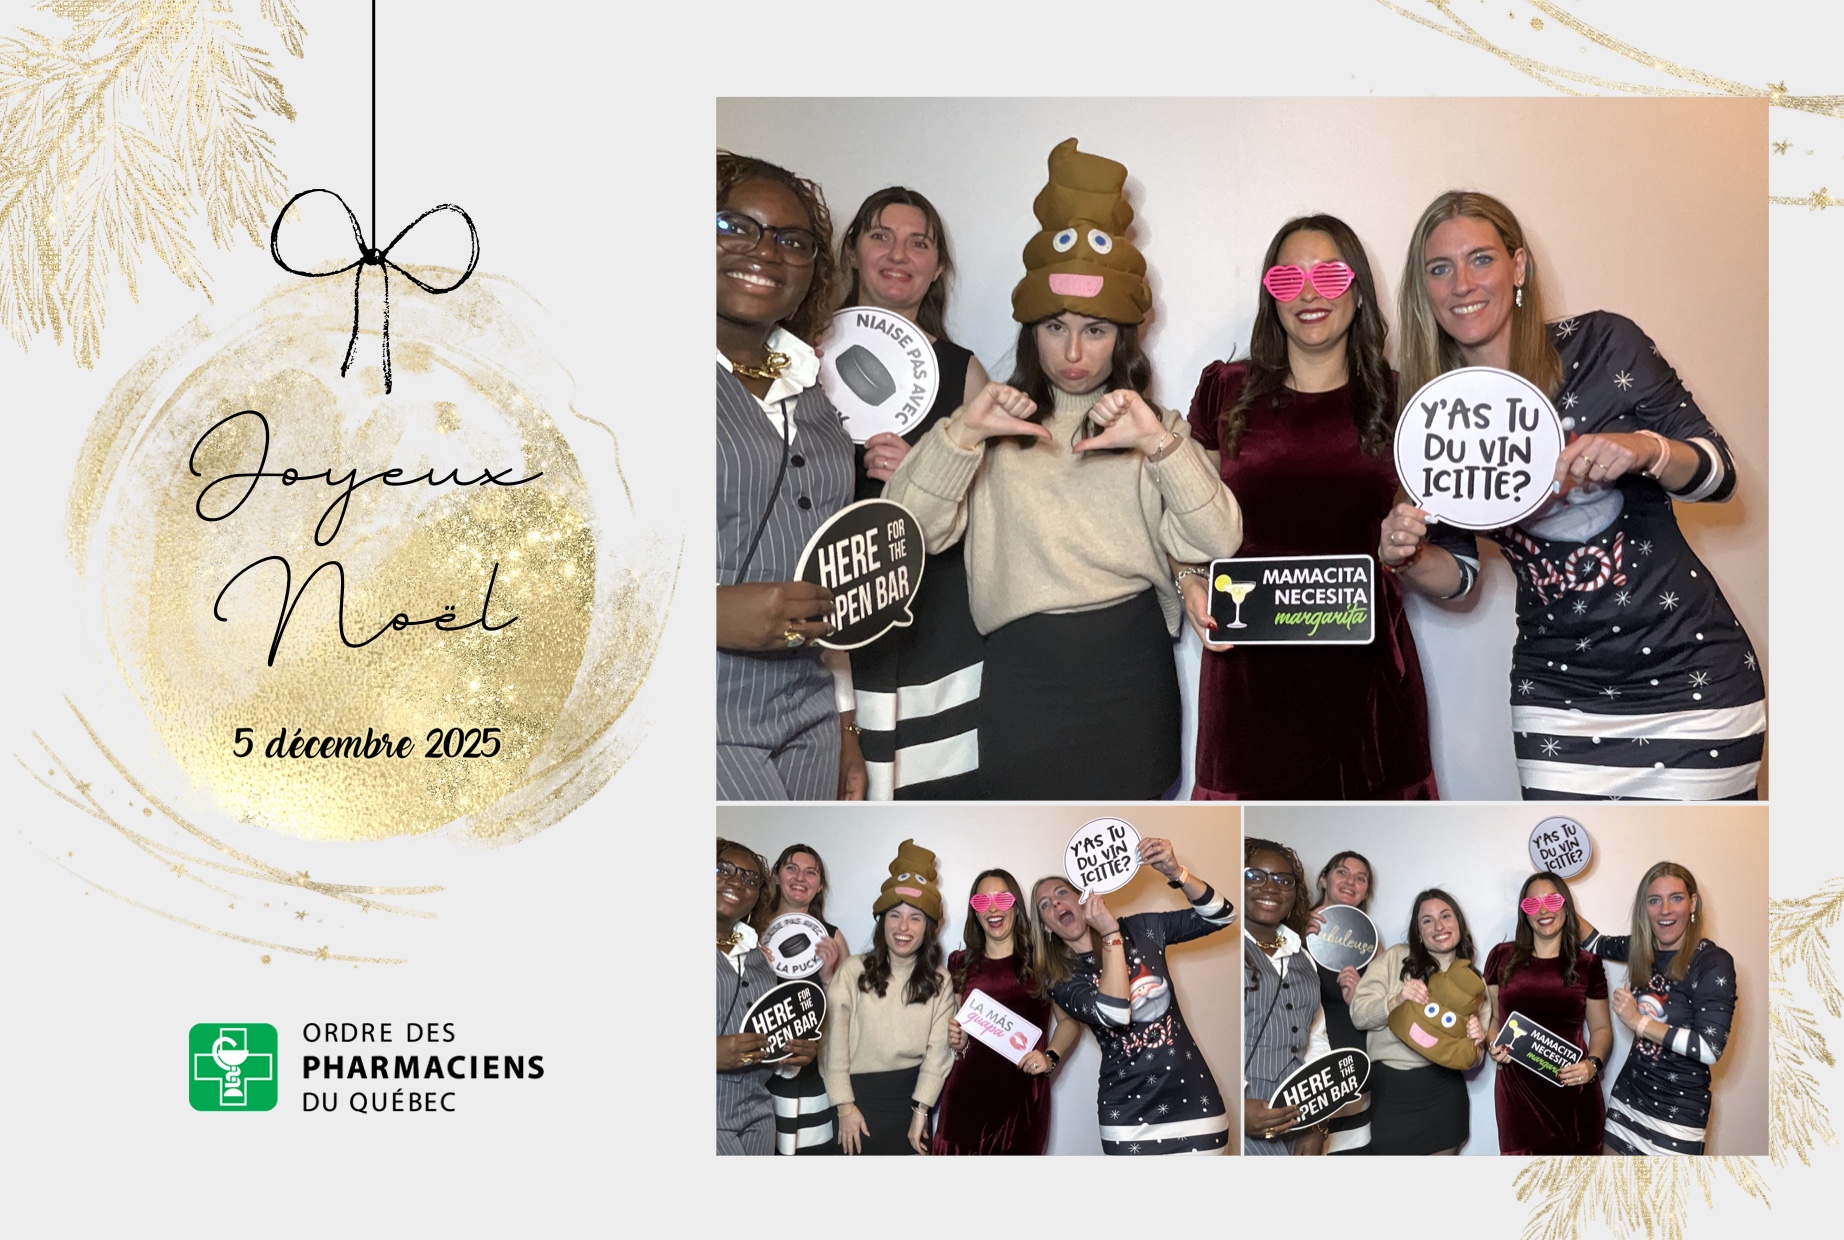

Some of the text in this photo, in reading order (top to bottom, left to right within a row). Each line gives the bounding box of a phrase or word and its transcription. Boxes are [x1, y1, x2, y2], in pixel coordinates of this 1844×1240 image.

[856, 313, 928, 425] NIAISE PAS AVEC
[1420, 397, 1539, 433] Y'AS TU
[1424, 433, 1531, 466] DU VIN
[1422, 466, 1531, 502] ICITTE?
[887, 518, 905, 541] FOR
[818, 527, 881, 589] HERE
[888, 538, 907, 562] THE
[875, 565, 910, 610] BAR
[1262, 566, 1368, 585] MAMACITA
[1274, 587, 1368, 605] NECESITA
[1274, 603, 1368, 636] margarita
[1106, 825, 1126, 842] TU
[1560, 823, 1577, 838] TU
[1077, 839, 1128, 871] DU VIN
[1540, 836, 1580, 860] DU VIN
[1544, 849, 1583, 873] ICITTE?
[1080, 855, 1131, 888] ICITTE?
[1319, 925, 1374, 955] abuleuse
[776, 962, 789, 973] LA
[797, 987, 811, 1002] FOR
[800, 997, 813, 1012] THE
[751, 997, 797, 1035] HERE
[962, 1012, 1005, 1038] guapa
[969, 998, 1014, 1032] LA MÁS
[761, 1010, 818, 1054] PEN BAR
[1530, 1029, 1577, 1062] MAMACITA
[1338, 1055, 1354, 1070] FOR
[1340, 1063, 1355, 1078] THE
[1283, 1066, 1334, 1106] HERE
[1296, 1075, 1358, 1122] PEN BAR
